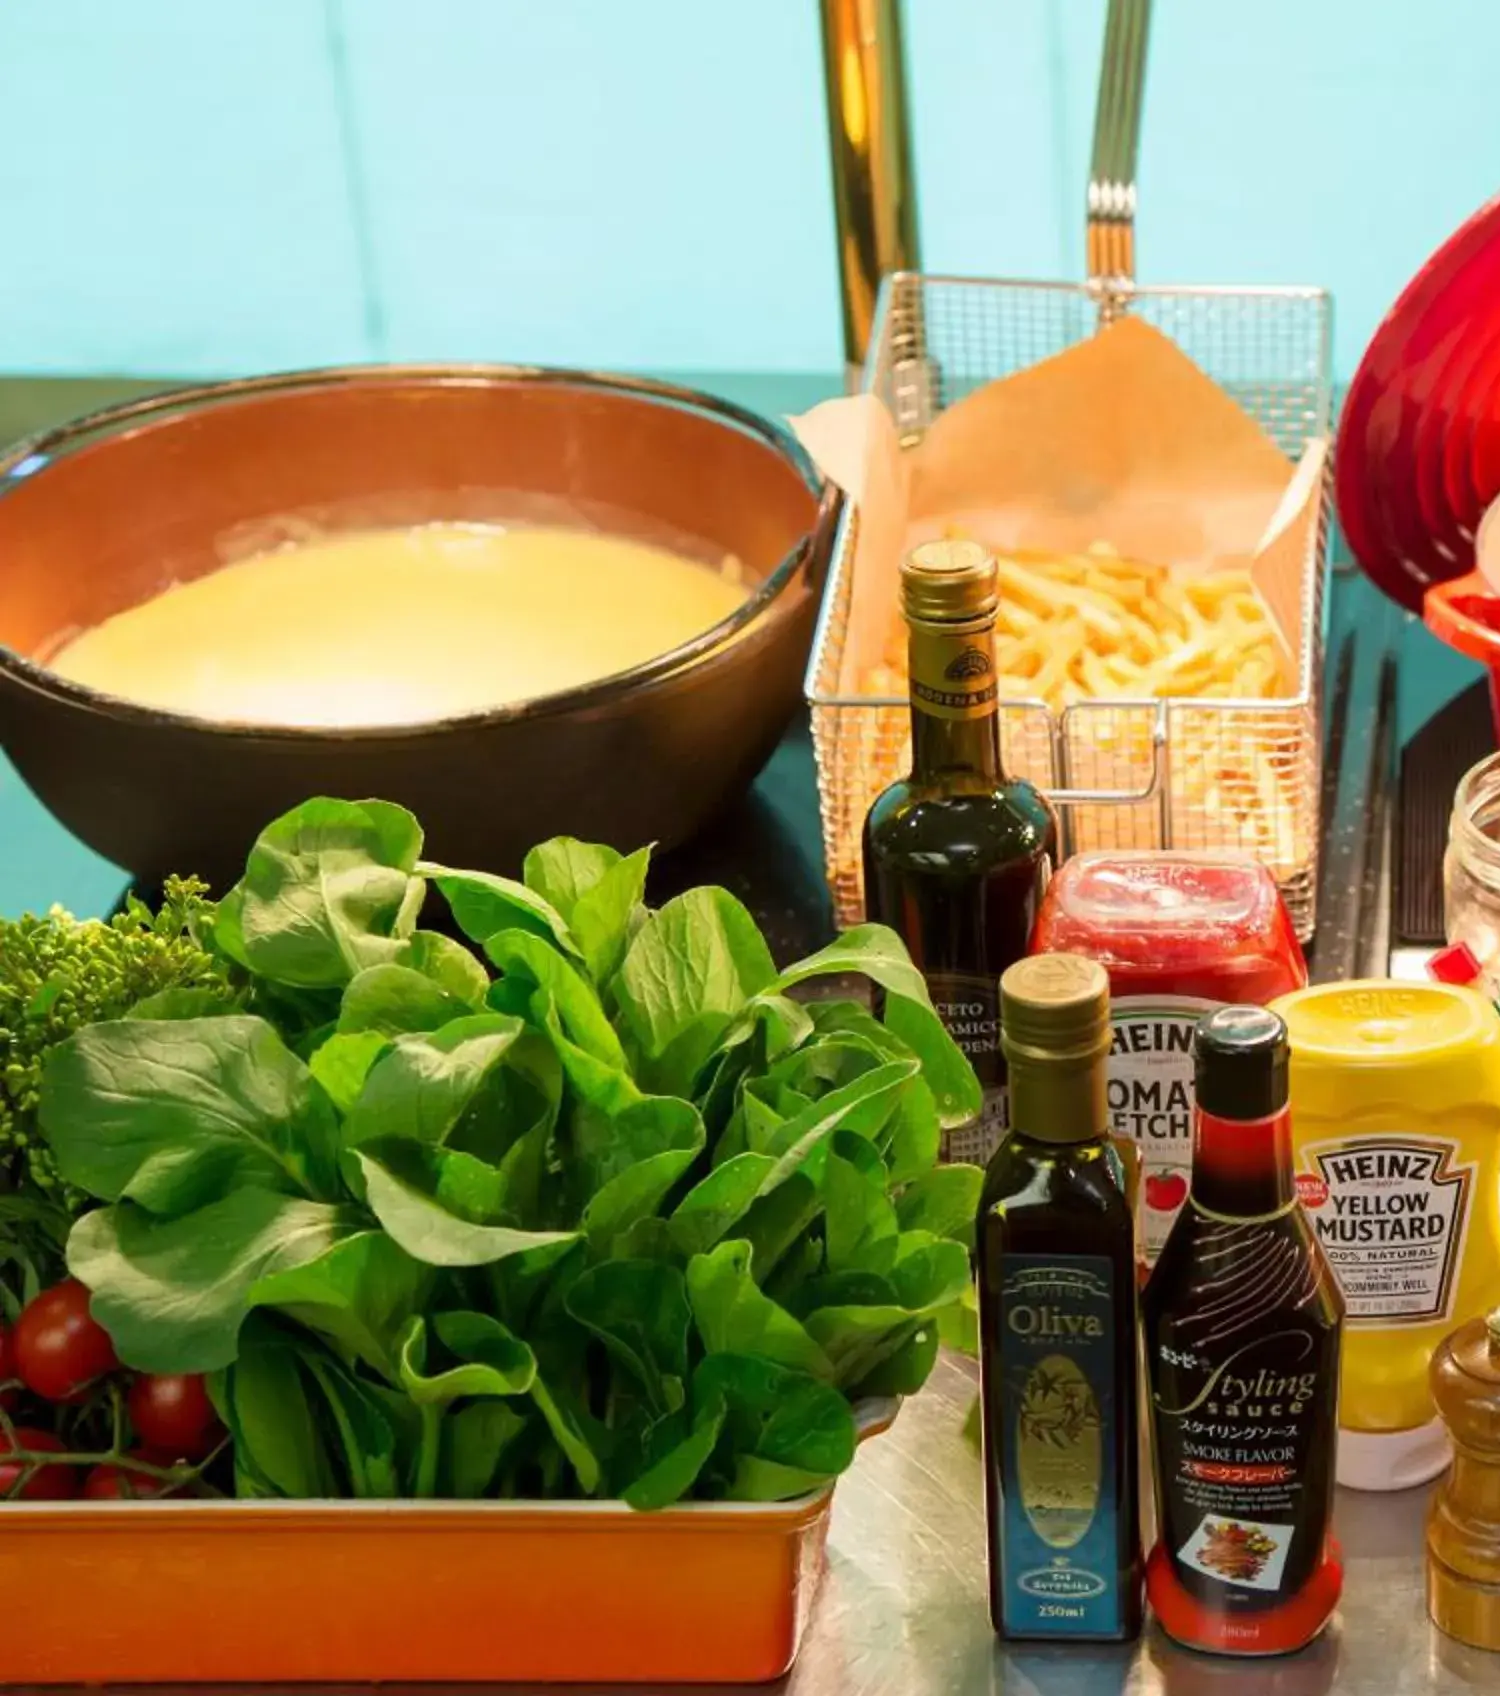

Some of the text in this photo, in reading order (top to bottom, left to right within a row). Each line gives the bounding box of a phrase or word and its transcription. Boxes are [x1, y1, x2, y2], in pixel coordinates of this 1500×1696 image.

[936, 1002, 984, 1016] CETO
[1109, 1023, 1194, 1056] HEIN
[1107, 1079, 1196, 1112] OMA
[1113, 1112, 1190, 1139] ETCH
[1331, 1154, 1432, 1184] HEINZ
[1332, 1191, 1431, 1216] YELLOW
[1316, 1213, 1446, 1243] MUSTARD
[1327, 1246, 1438, 1261] 00% NATURAL
[1007, 1304, 1105, 1337] Oliva
[1154, 1329, 1317, 1415] Styling
[1207, 1401, 1304, 1418] sauce
[1180, 1419, 1298, 1440] スタイリングソース
[1183, 1440, 1296, 1462] SMOKE FLAVOR
[1180, 1460, 1298, 1480] スモークフレーバー
[1038, 1605, 1085, 1618] 250ml
